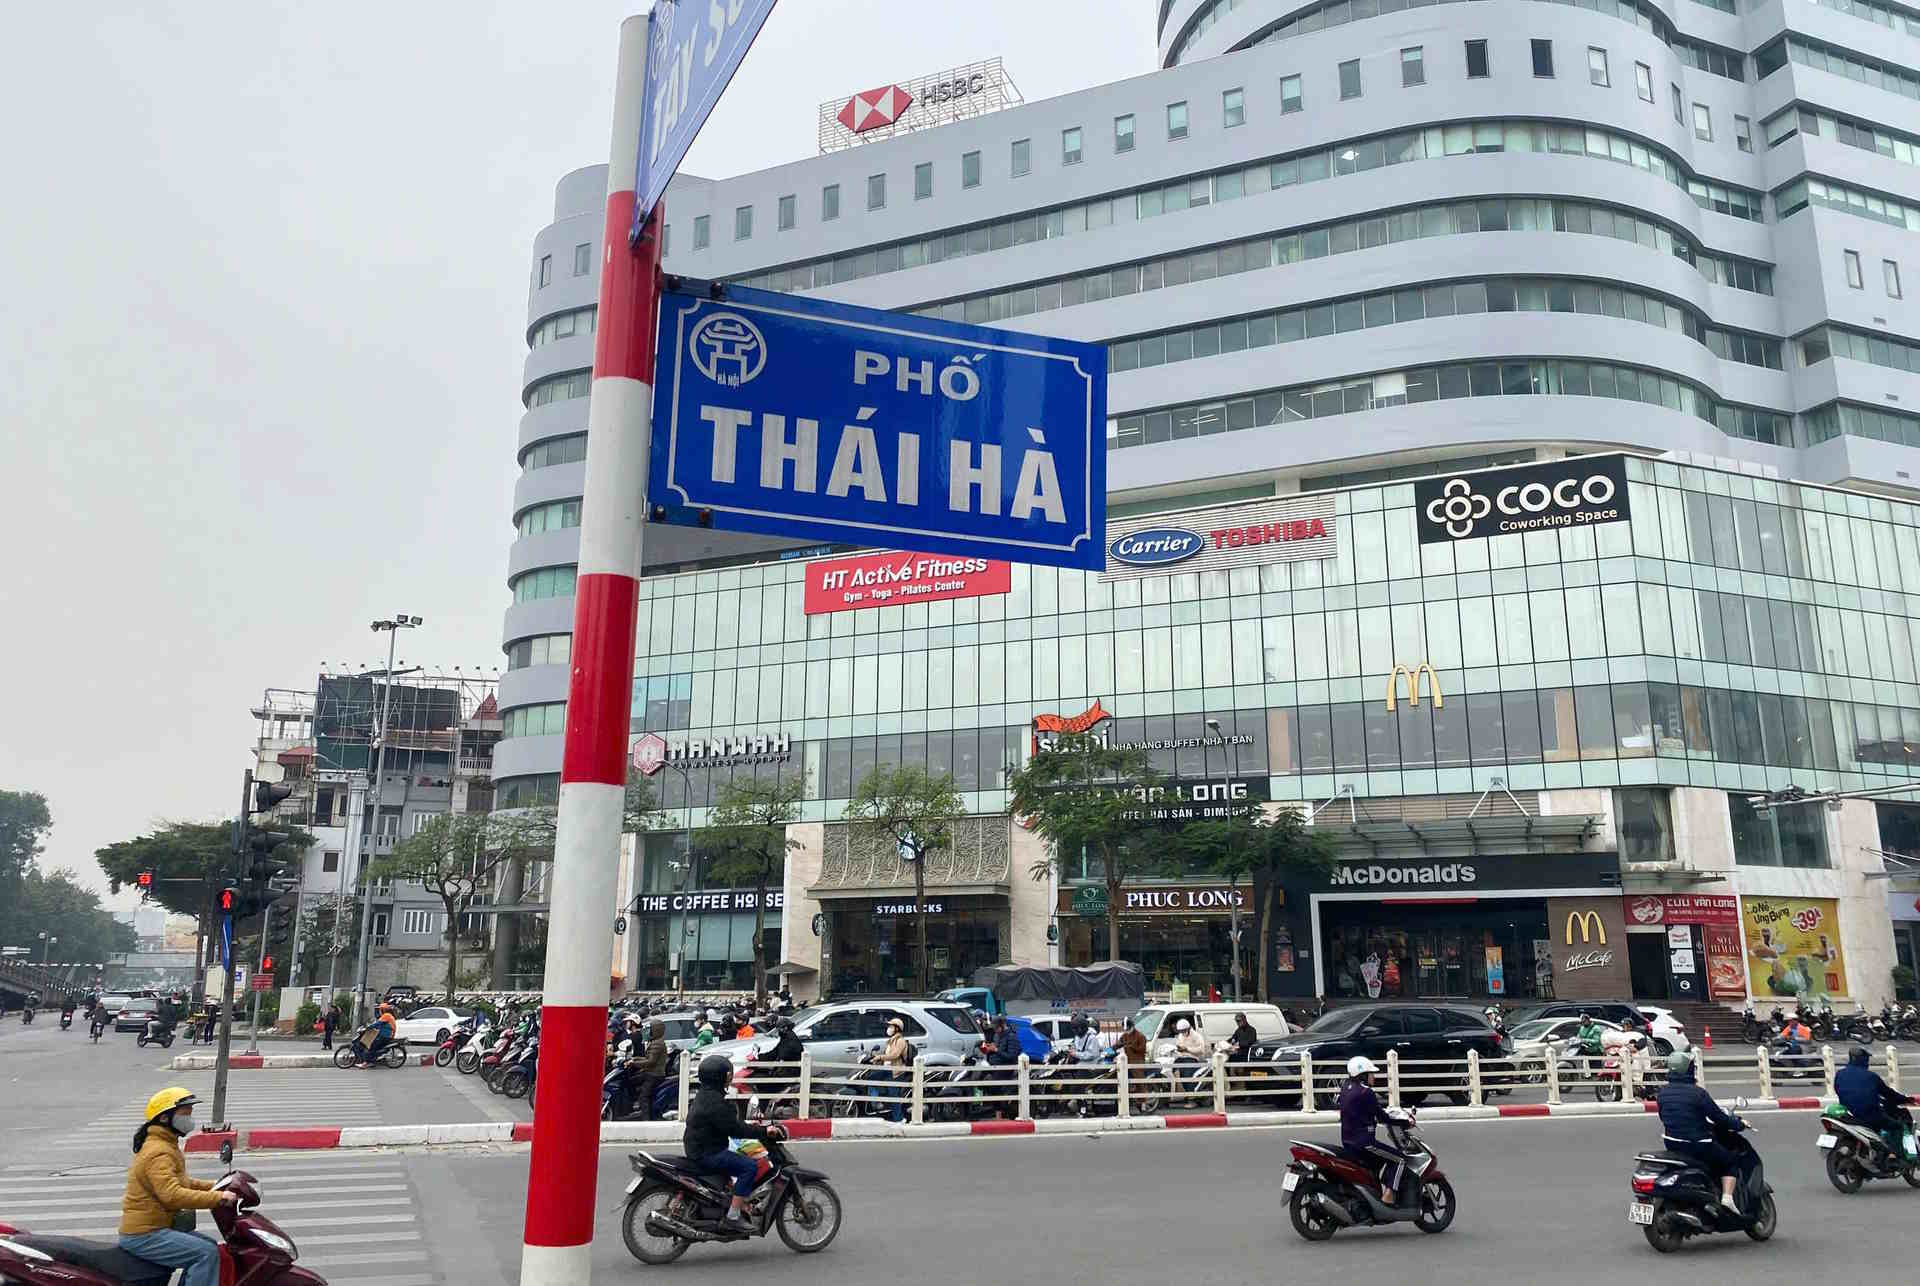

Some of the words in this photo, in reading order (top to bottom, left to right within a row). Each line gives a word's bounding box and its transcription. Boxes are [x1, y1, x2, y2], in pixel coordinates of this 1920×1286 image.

[921, 73, 984, 107] HSBC
[853, 352, 985, 401] PHỐ
[700, 407, 919, 505] THÁI
[949, 426, 1067, 524] HÀ
[1497, 475, 1616, 514] COGO
[1500, 513, 1572, 531] Coworking
[1575, 509, 1618, 527] Space
[1118, 535, 1193, 556] Carrier
[1209, 518, 1328, 549] TOSHIBA
[823, 569, 849, 591] HT
[850, 556, 914, 588] Active
[915, 557, 988, 580] Fitness
[843, 590, 863, 604] Gym
[871, 587, 893, 602] Yoga
[901, 583, 933, 597] Pilates
[934, 580, 966, 592] Center
[670, 731, 791, 760] MANWAH
[1164, 737, 1201, 748] BUFFET
[1330, 864, 1477, 884] McDonald's
[642, 897, 668, 911] THE
[1188, 890, 1244, 907] LONG
